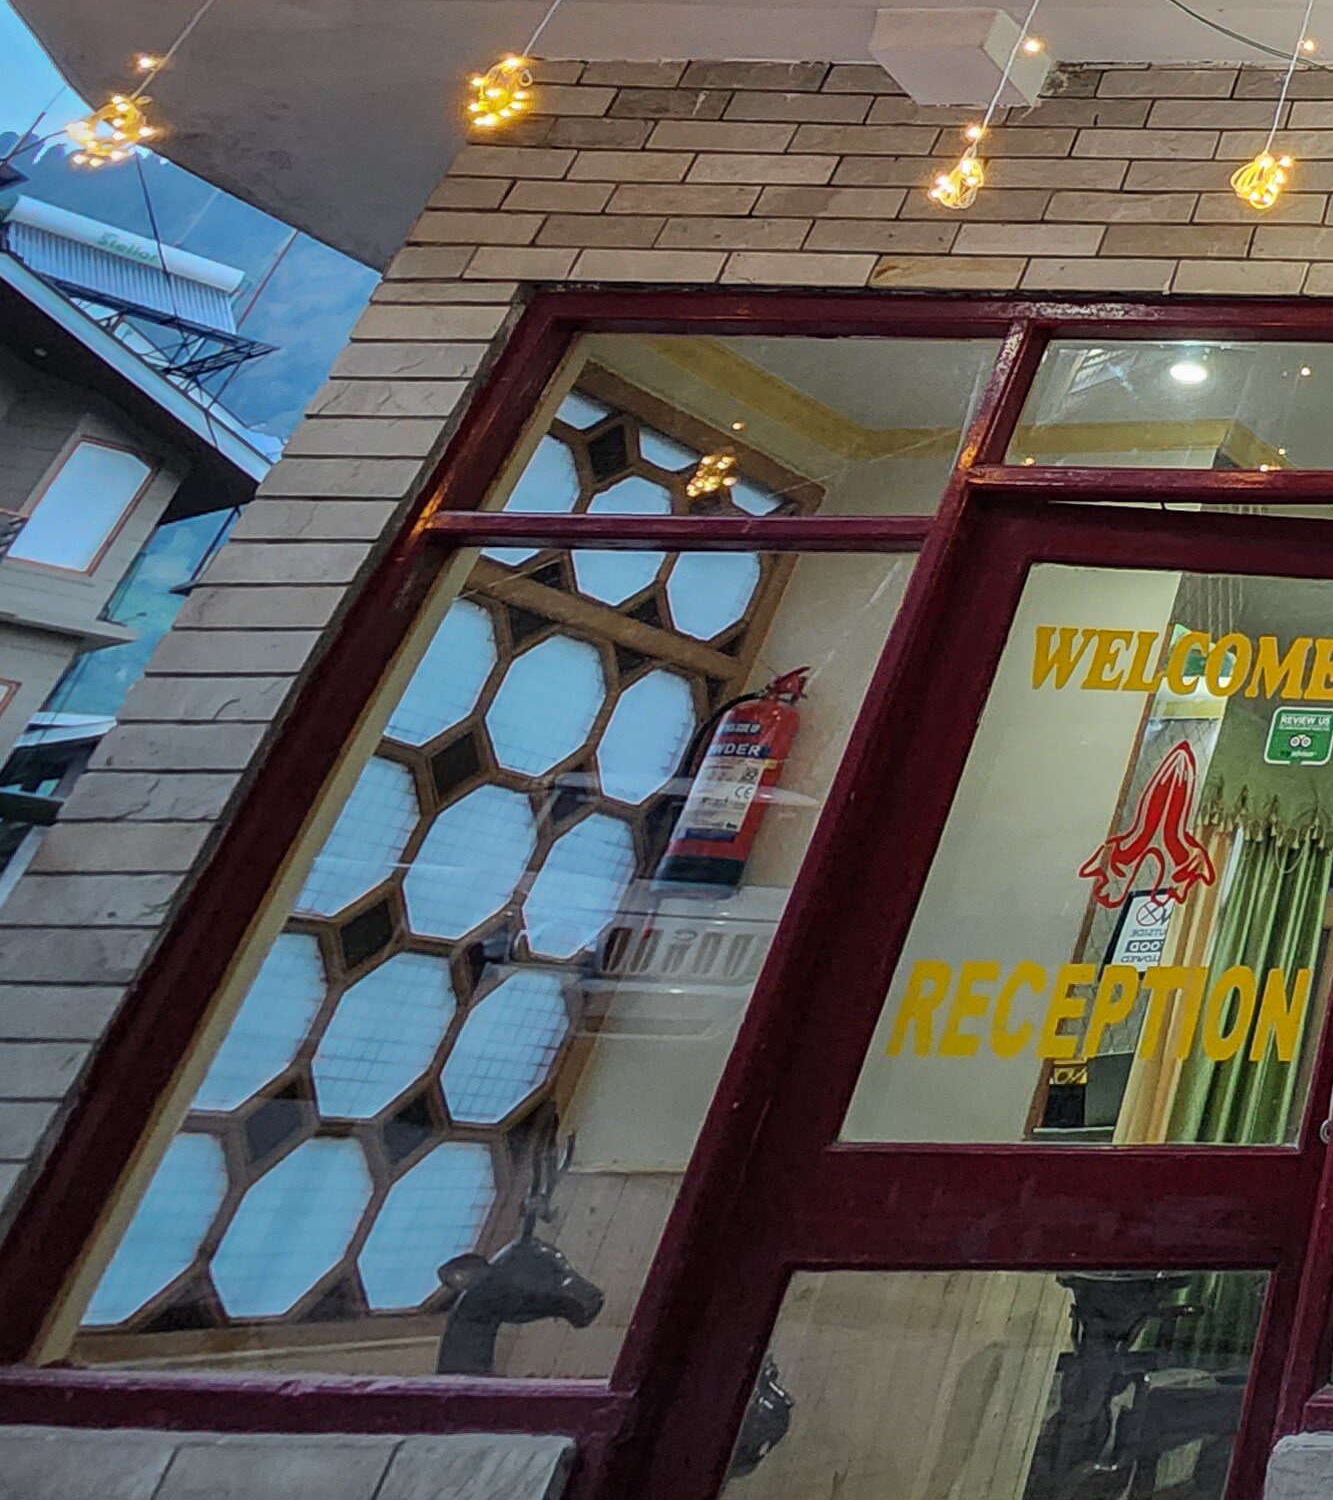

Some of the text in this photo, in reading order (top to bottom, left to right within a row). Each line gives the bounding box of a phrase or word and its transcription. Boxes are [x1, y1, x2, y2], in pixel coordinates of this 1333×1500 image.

[1281, 715, 1331, 726] REVIEW US
[886, 960, 1312, 1063] RECEPTION
